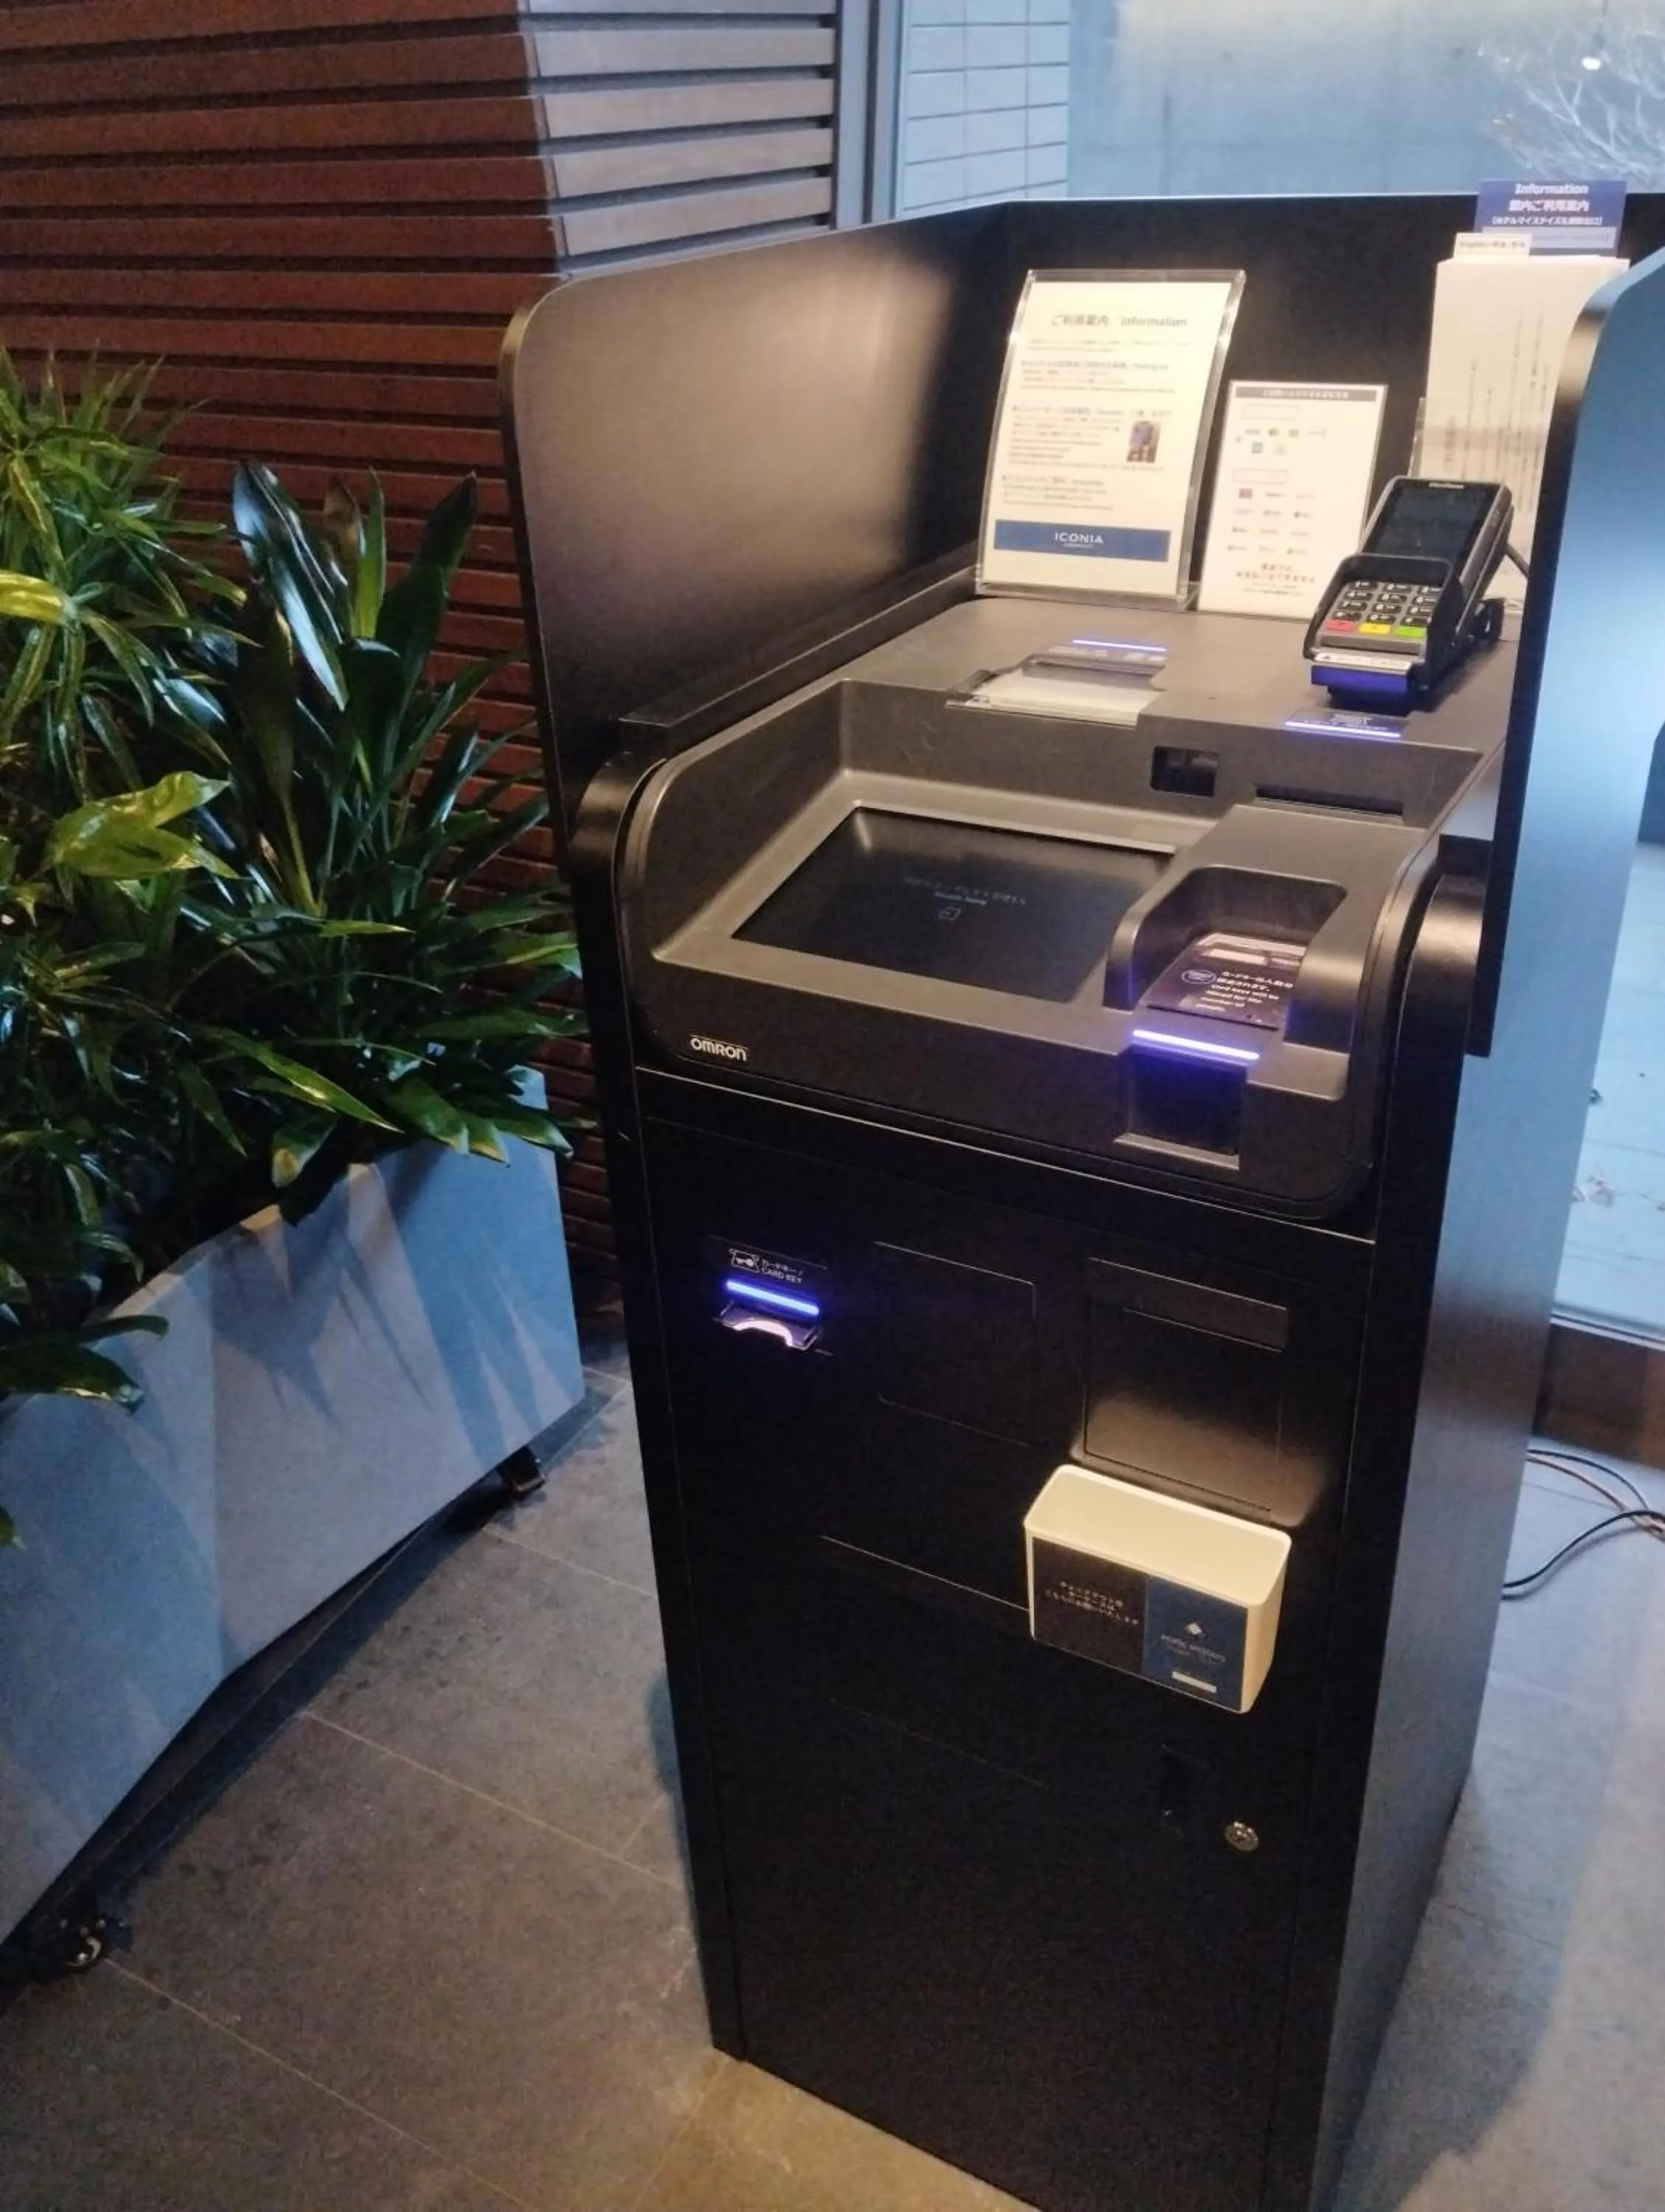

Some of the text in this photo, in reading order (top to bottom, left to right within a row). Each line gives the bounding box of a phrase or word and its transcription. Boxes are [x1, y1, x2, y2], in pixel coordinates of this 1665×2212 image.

[1515, 183, 1589, 195] Information
[1054, 531, 1104, 543] ICONIA
[785, 1273, 802, 1284] KEY
